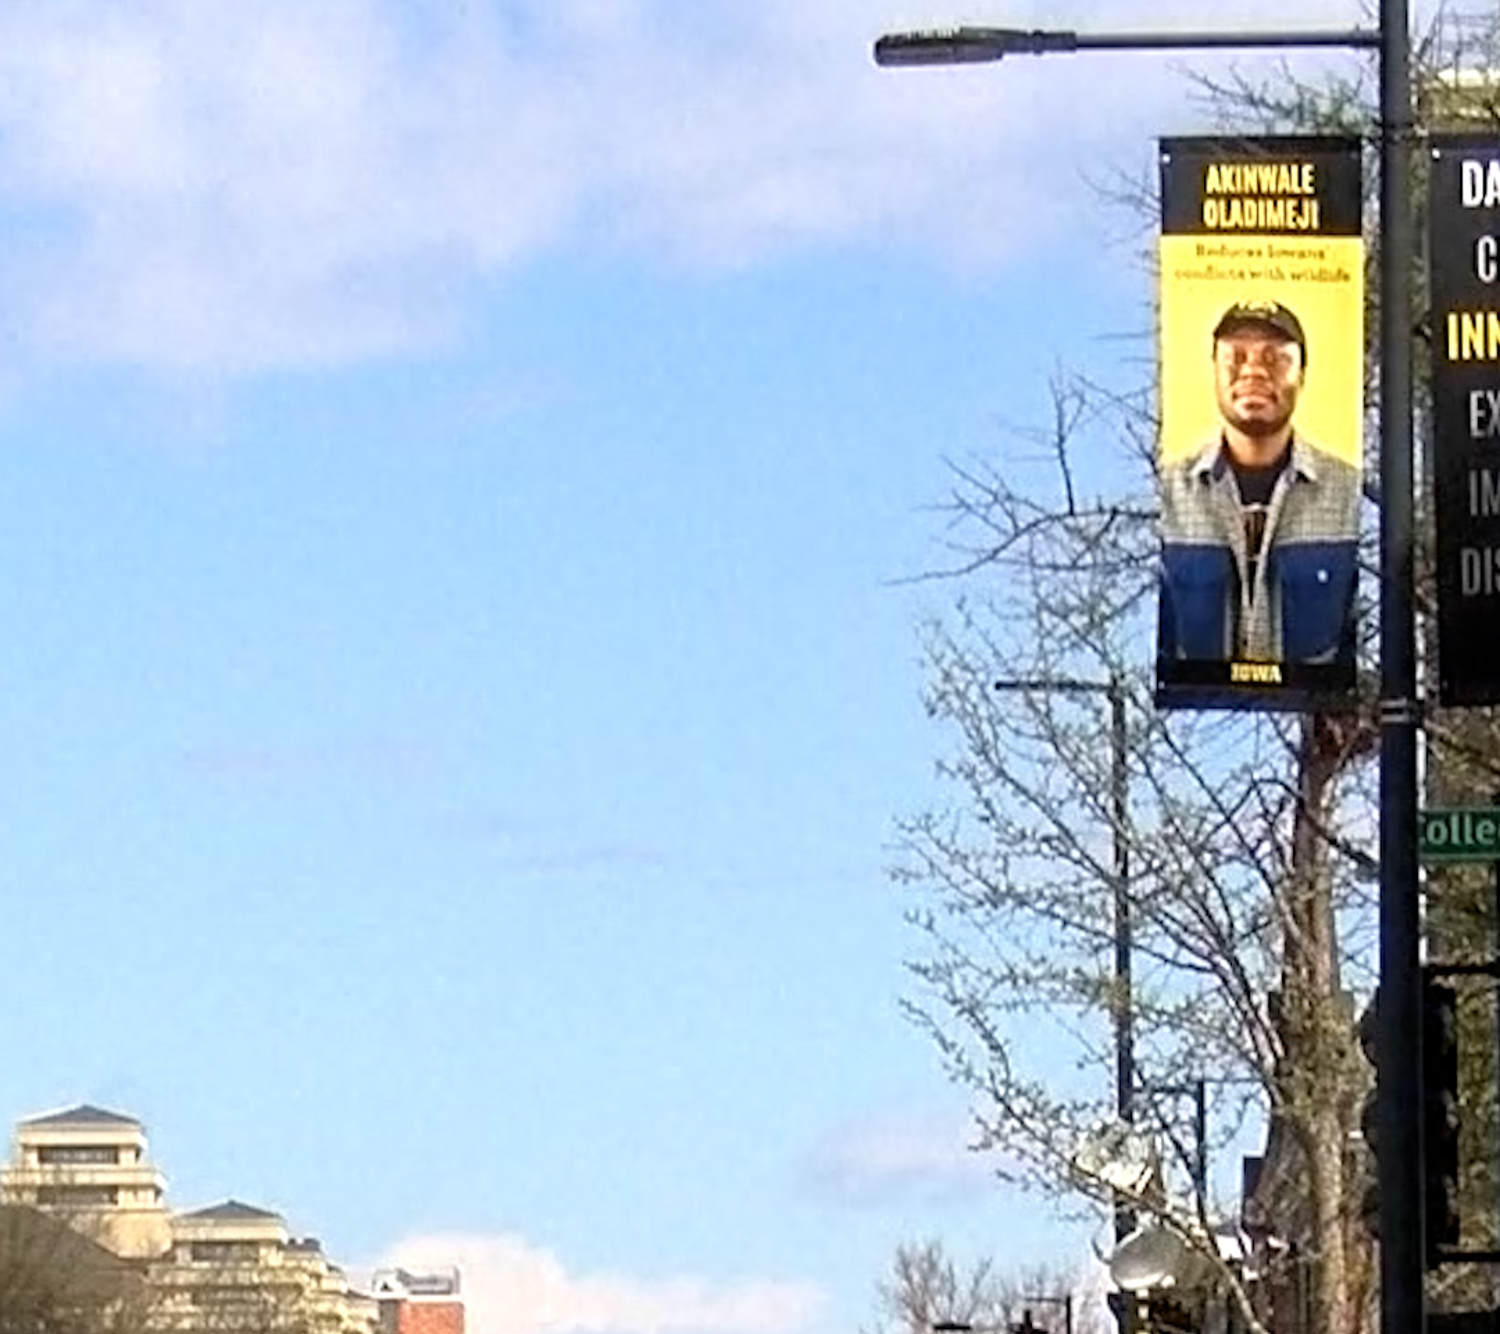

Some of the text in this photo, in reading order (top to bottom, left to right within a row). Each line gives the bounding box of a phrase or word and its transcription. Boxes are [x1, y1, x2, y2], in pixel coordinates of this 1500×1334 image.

[1205, 164, 1316, 194] AKINWALE
[1203, 199, 1319, 230] OLADIMEJI
[1230, 662, 1283, 684] IOWA
[1418, 813, 1500, 846] olle
